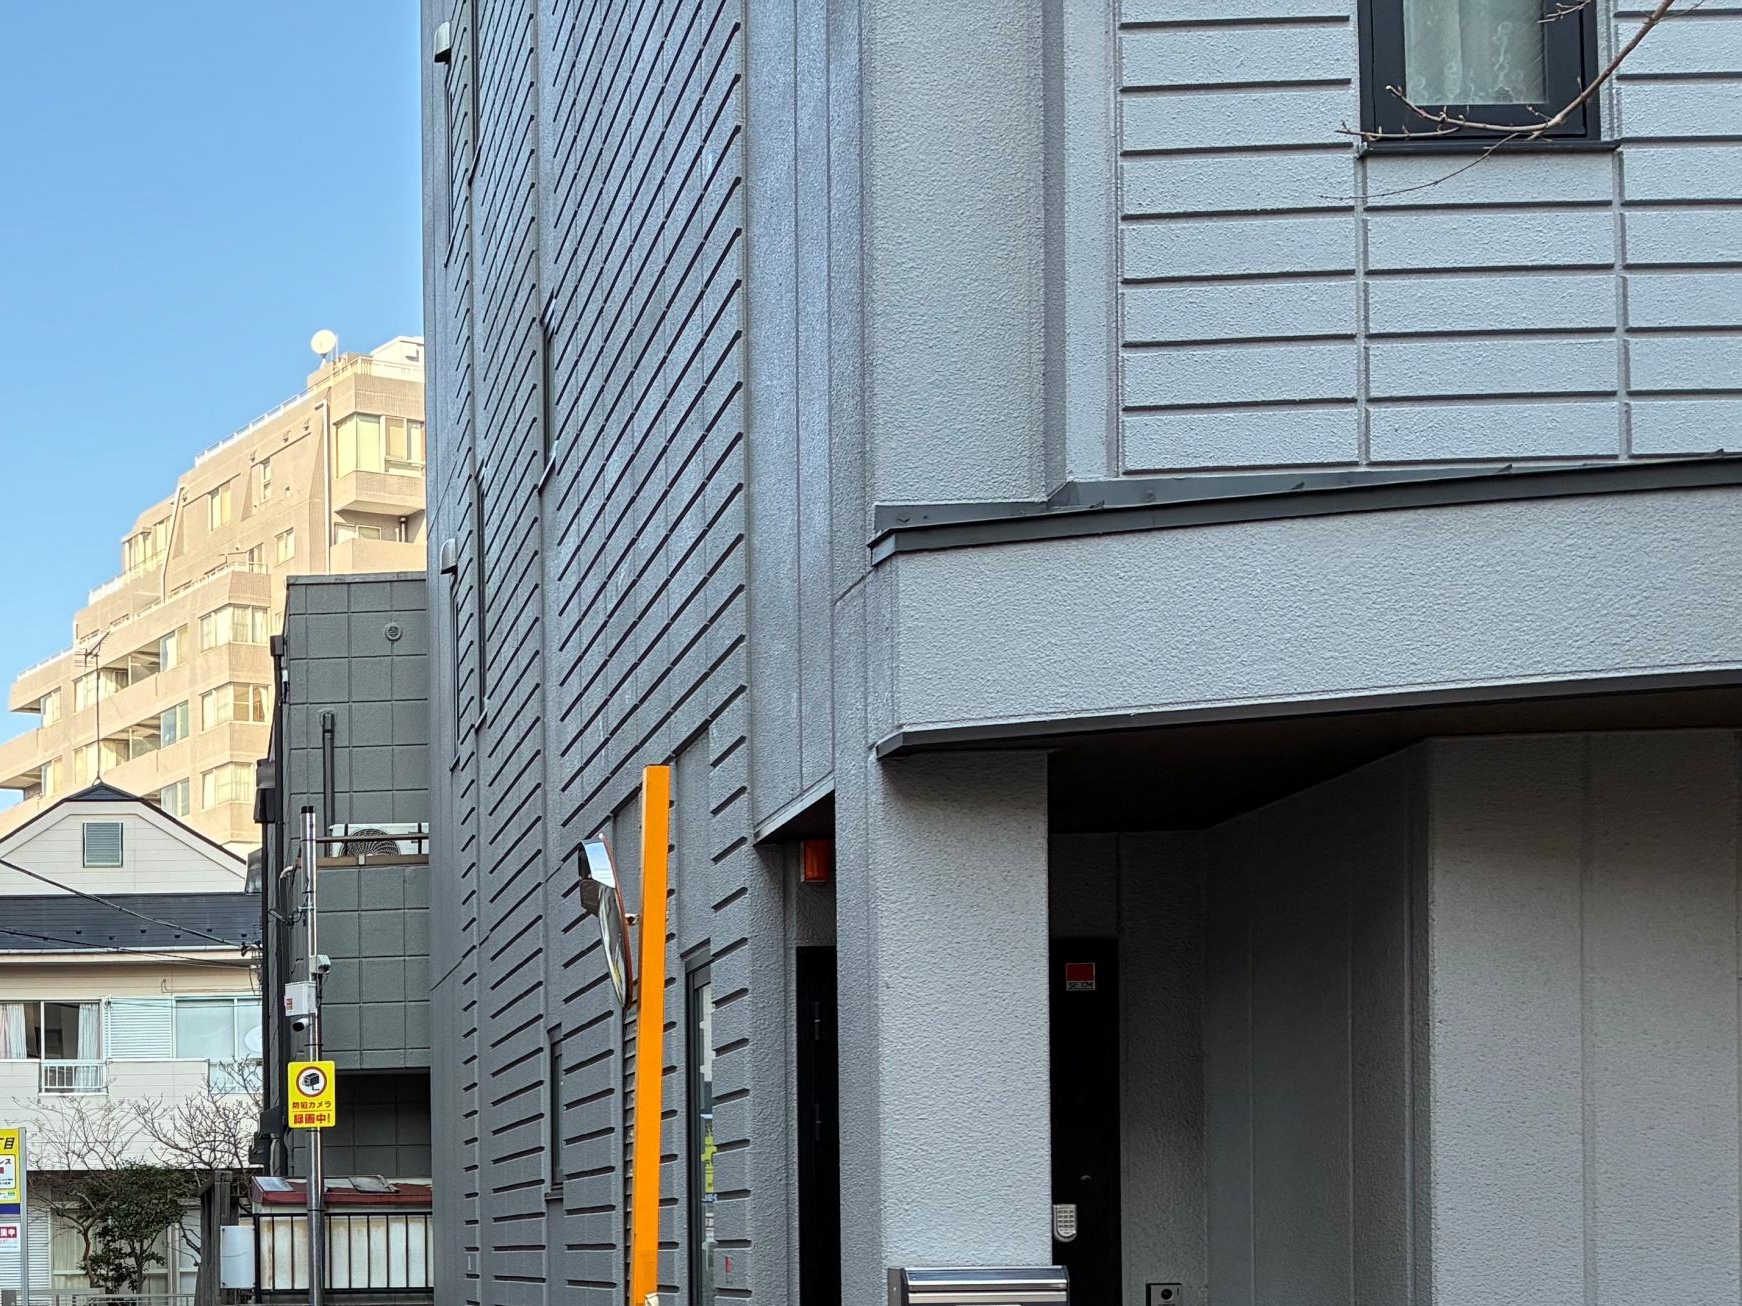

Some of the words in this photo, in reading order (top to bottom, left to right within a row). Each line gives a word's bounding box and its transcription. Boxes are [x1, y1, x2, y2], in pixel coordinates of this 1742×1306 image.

[292, 1101, 332, 1110] 防犯カメラ
